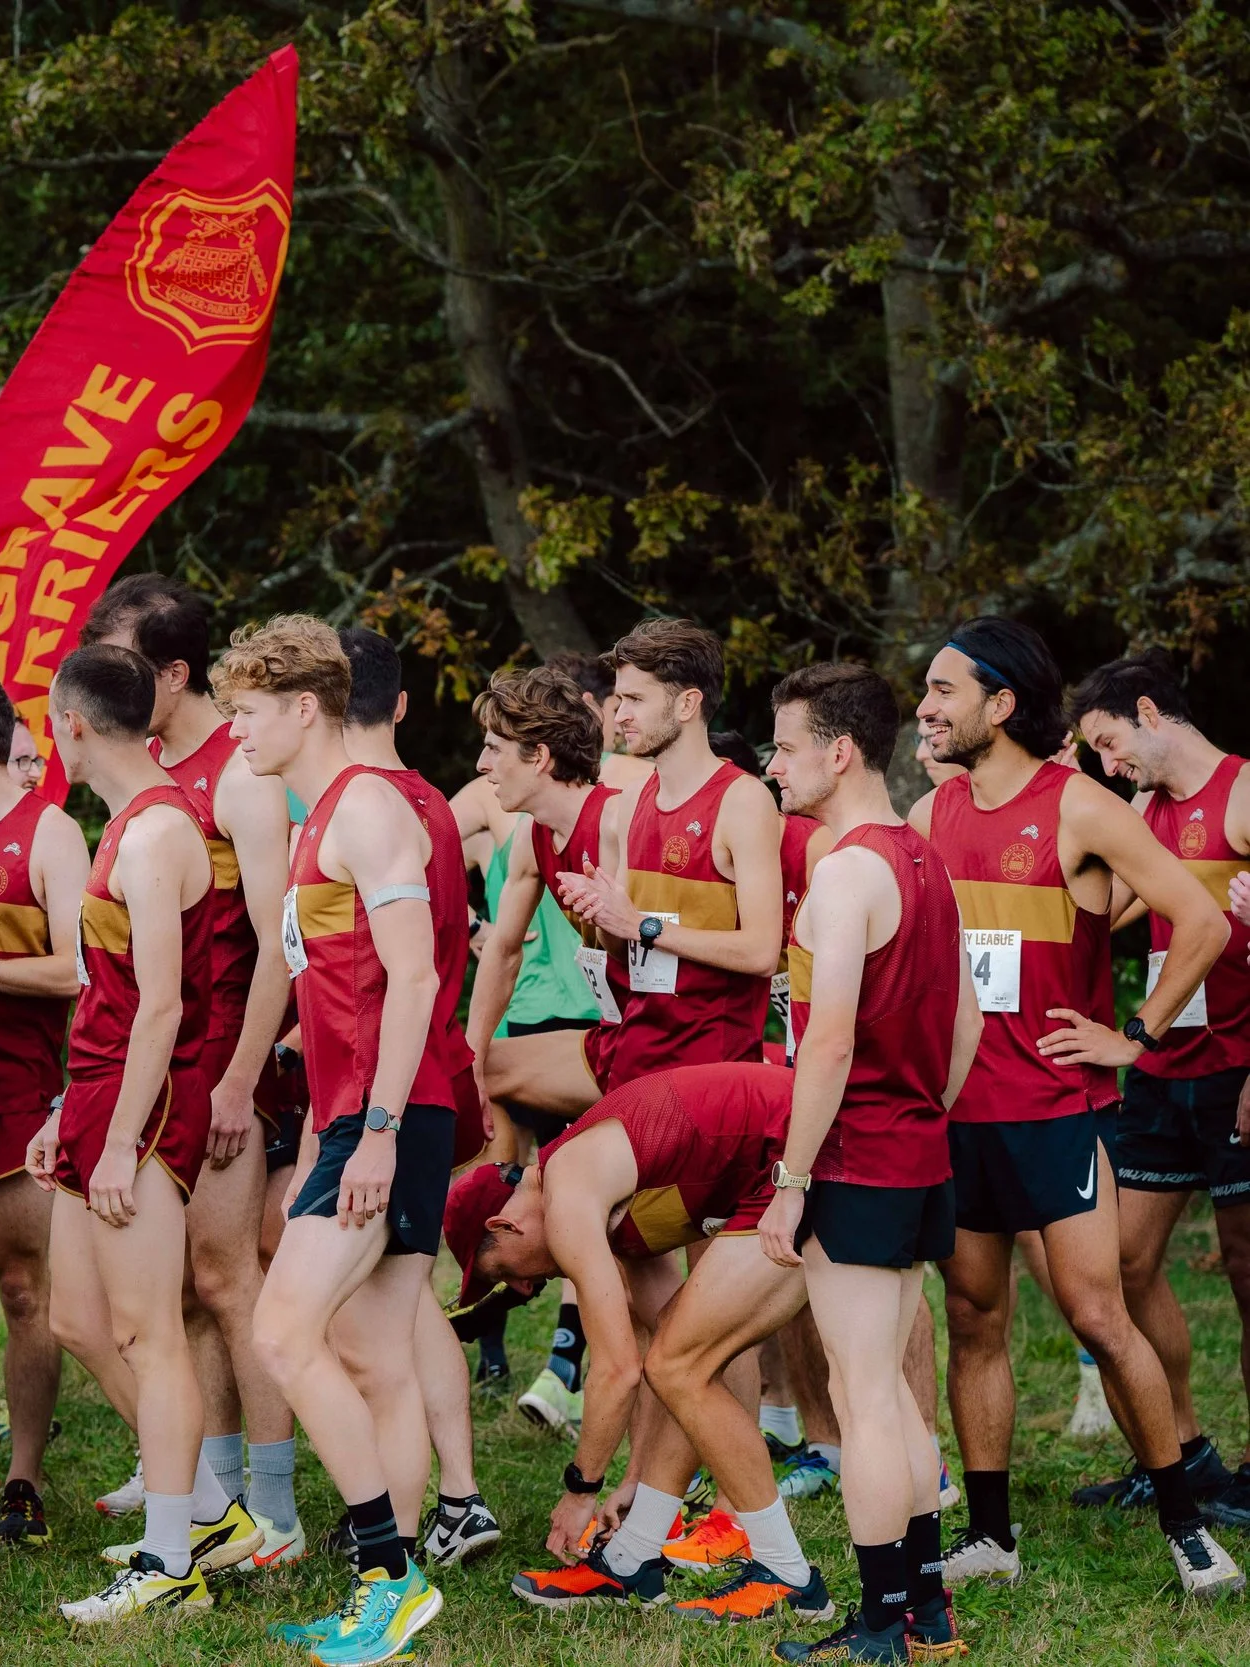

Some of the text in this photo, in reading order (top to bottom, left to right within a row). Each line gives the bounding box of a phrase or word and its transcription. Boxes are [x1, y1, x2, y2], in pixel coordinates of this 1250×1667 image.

[13, 393, 223, 786] ARRIERS
[975, 933, 1014, 946] LEAGUE
[366, 1590, 402, 1639] HOKA
[805, 1645, 851, 1663] HOKA
